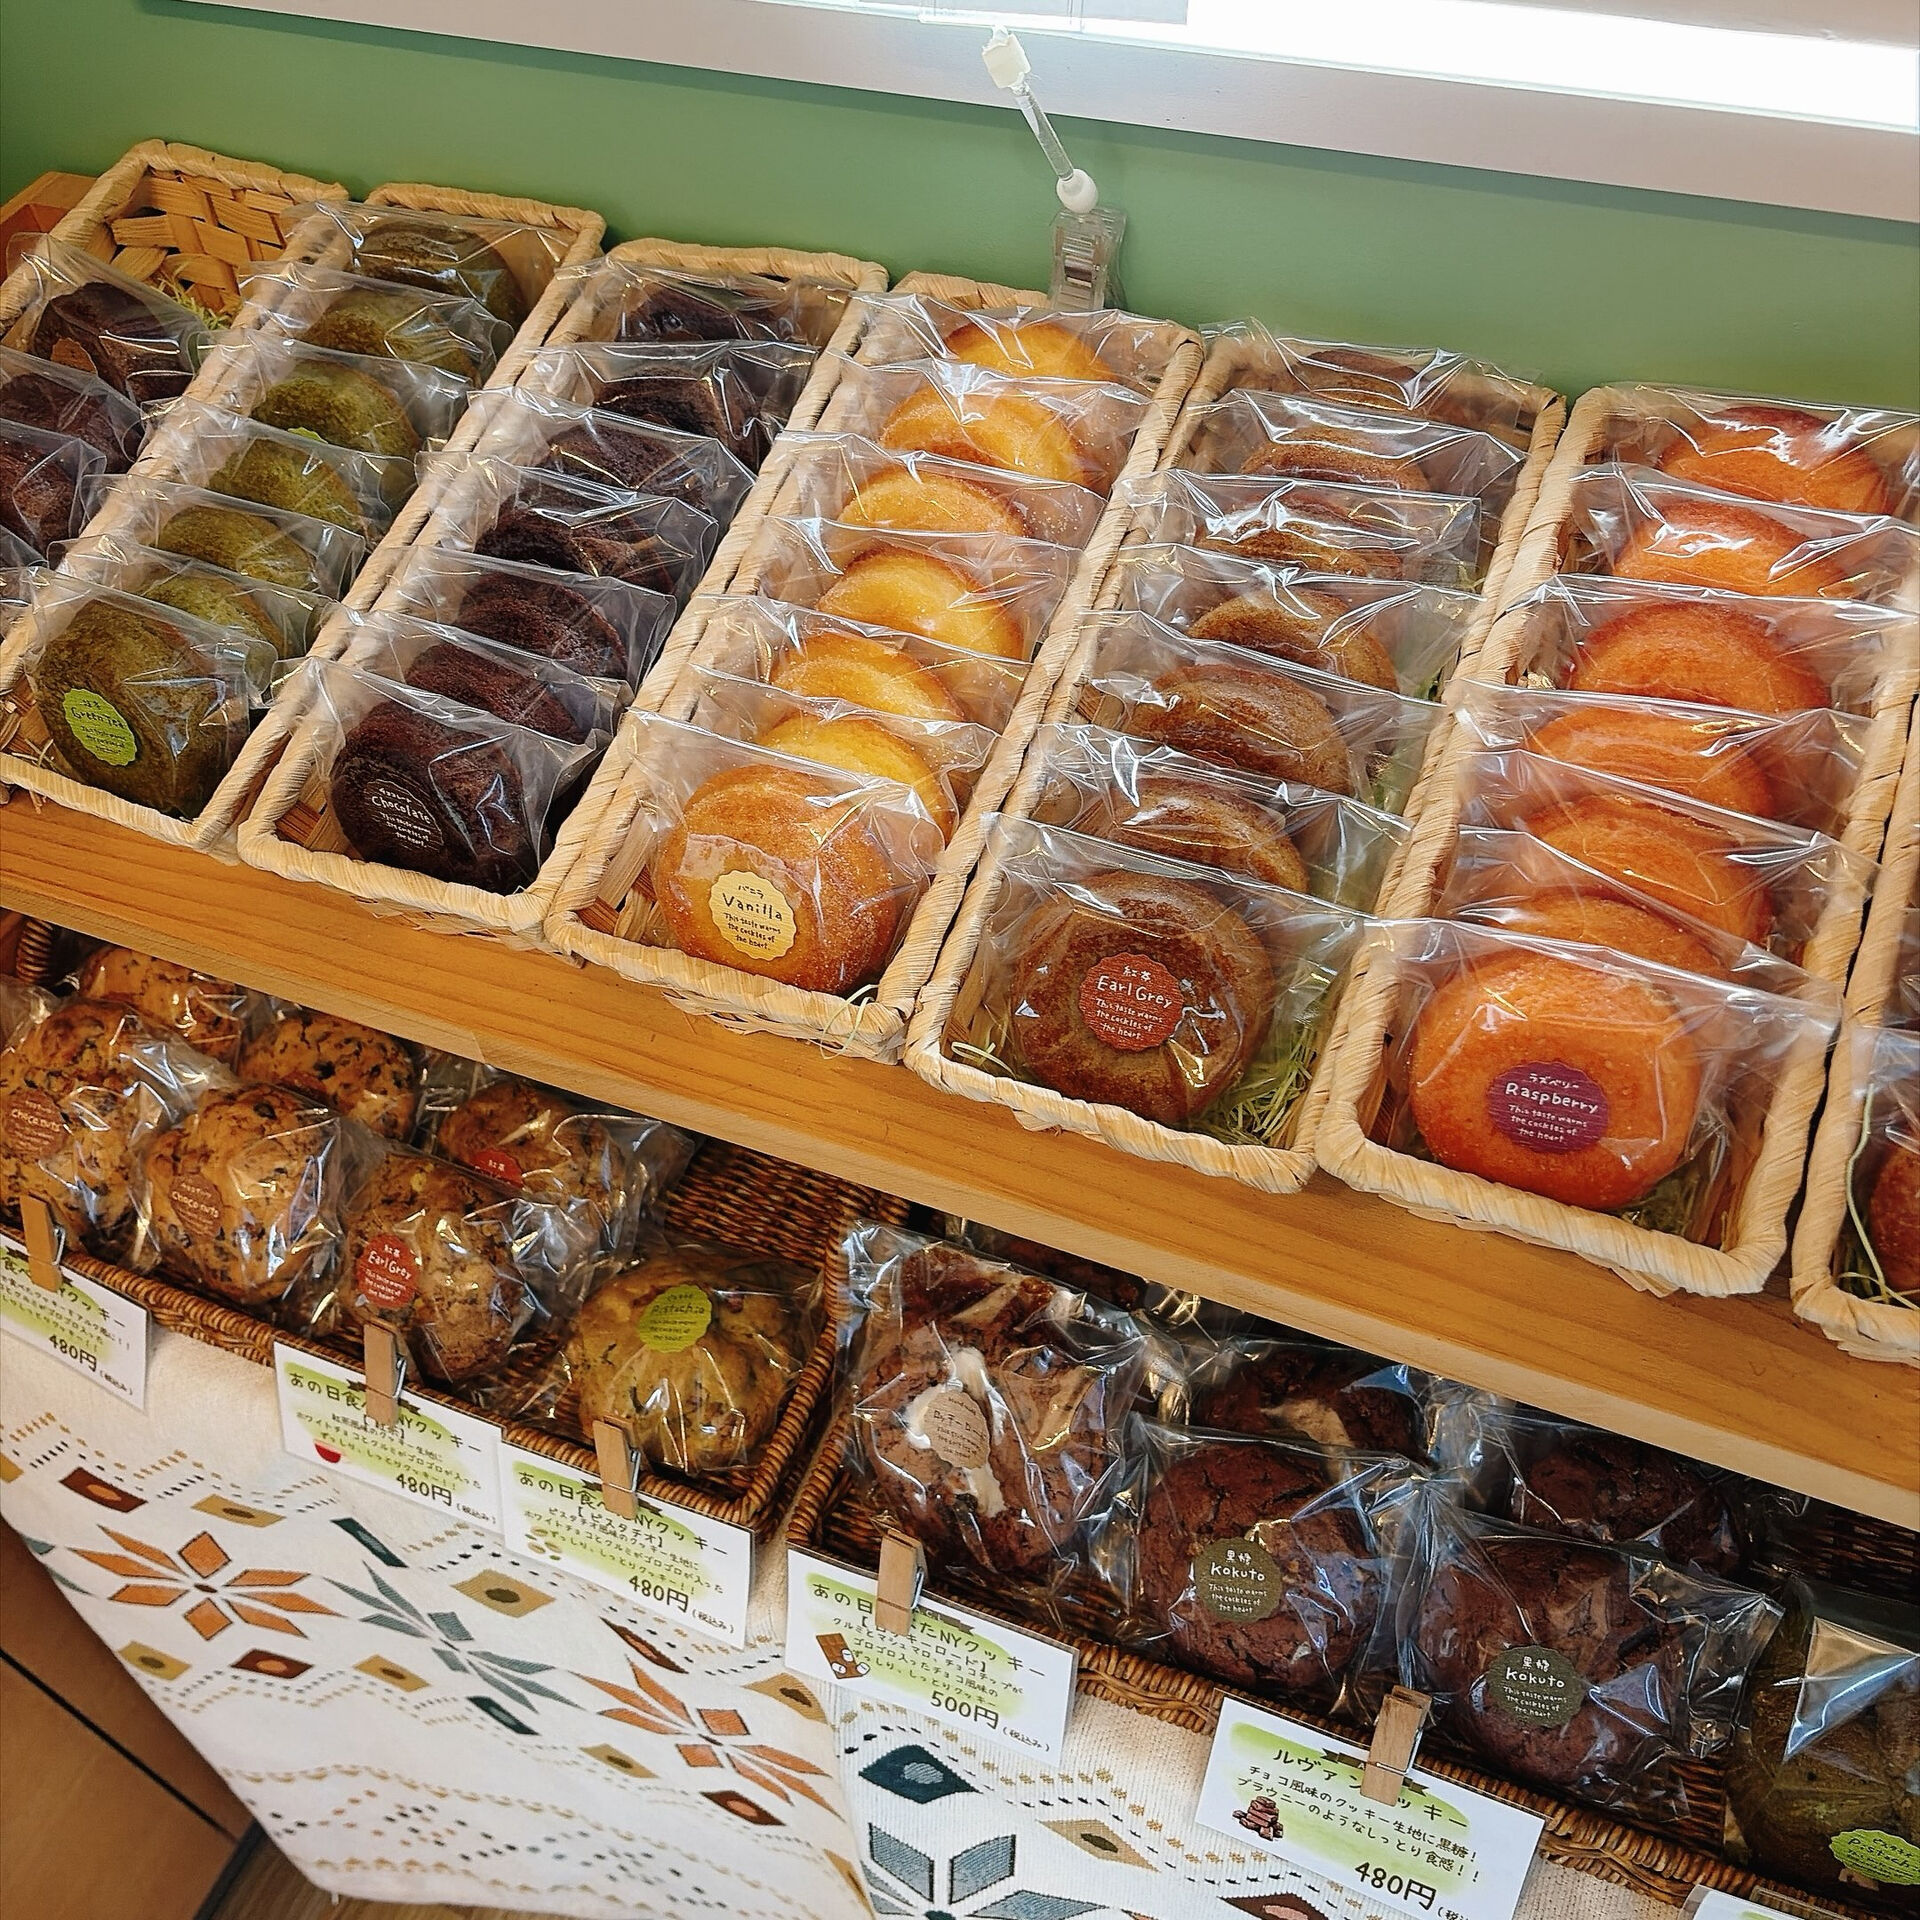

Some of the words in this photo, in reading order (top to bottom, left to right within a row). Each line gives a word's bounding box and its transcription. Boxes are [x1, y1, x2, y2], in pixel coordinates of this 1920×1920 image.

[371, 796, 431, 824] Chocolate
[738, 885, 764, 899] バニラ
[722, 893, 783, 921] Vanilla
[724, 912, 739, 922] This
[740, 917, 757, 929] taste
[728, 922, 739, 932] the
[740, 927, 766, 940] cockles
[768, 935, 776, 943] of
[1096, 975, 1132, 996] Earl
[1135, 986, 1173, 1008] Grey
[1095, 998, 1113, 1009] This
[1116, 1003, 1136, 1015] taste
[1138, 1012, 1163, 1023] warms
[1096, 1009, 1110, 1020] the
[1111, 1015, 1142, 1030] cockles
[1143, 1023, 1153, 1032] of
[1102, 1023, 1116, 1033] the
[1529, 1073, 1580, 1089] ラズベリー
[1505, 1082, 1599, 1114] Raspberry
[1508, 1104, 1530, 1115] This
[1532, 1109, 1556, 1121] taste
[1558, 1116, 1588, 1128] warms
[1511, 1115, 1526, 1125] the
[1528, 1120, 1565, 1133] cockles
[1566, 1128, 1578, 1136] of
[1519, 1128, 1535, 1137] the
[172, 1191, 199, 1208] Choco
[368, 1250, 388, 1268] Earl
[388, 1260, 412, 1280] Grey
[651, 1302, 705, 1314] Pistachio
[49, 1335, 97, 1372] 480円
[396, 1473, 452, 1507] 480円
[1226, 1549, 1252, 1566] 黒糖
[628, 1575, 689, 1613] 480円
[1208, 1583, 1224, 1592] This
[1225, 1586, 1243, 1595] taste
[1522, 1655, 1550, 1672] 黒糖
[1503, 1686, 1520, 1695] This
[1521, 1691, 1541, 1700] taste
[930, 1689, 1000, 1730] 500円
[1273, 1749, 1468, 1828] ルヴァンッキー
[1249, 1765, 1477, 1863] チョコ風味のクッキー生地に黒糖！
[1237, 1777, 1479, 1883] ブラウニーのようなしっとり食感！！
[1354, 1861, 1437, 1911] 480円
